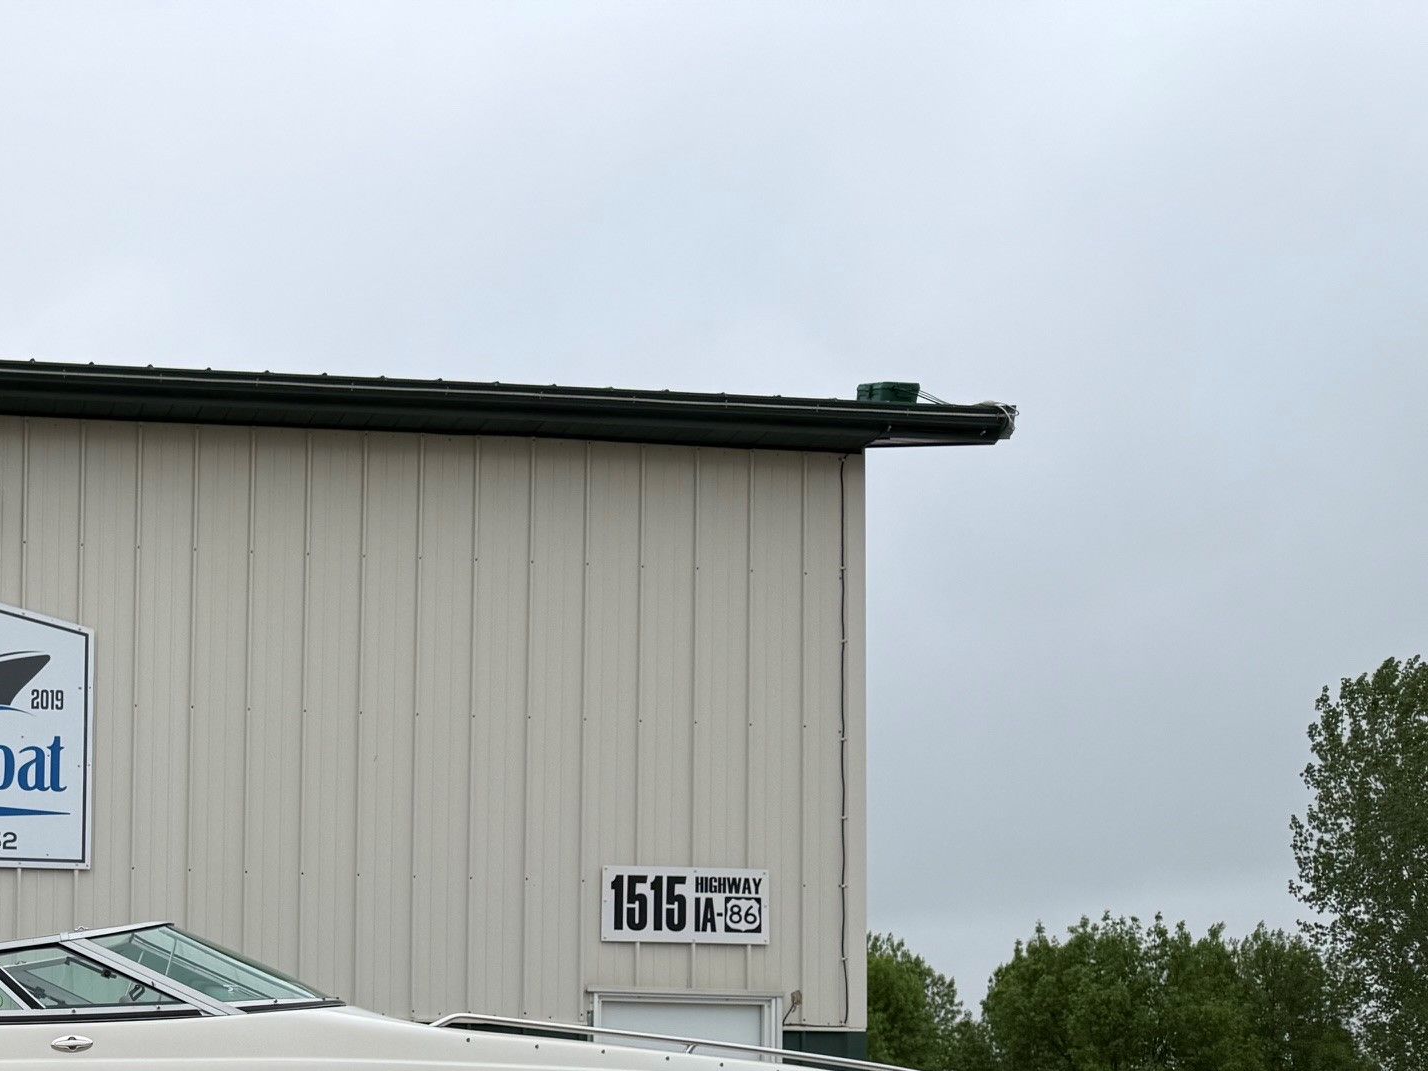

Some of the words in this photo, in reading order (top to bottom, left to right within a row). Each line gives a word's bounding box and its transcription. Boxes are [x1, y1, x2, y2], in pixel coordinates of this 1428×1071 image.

[30, 689, 64, 711] 2019
[694, 876, 763, 895] HIGHWAY
[610, 874, 687, 932] 1515
